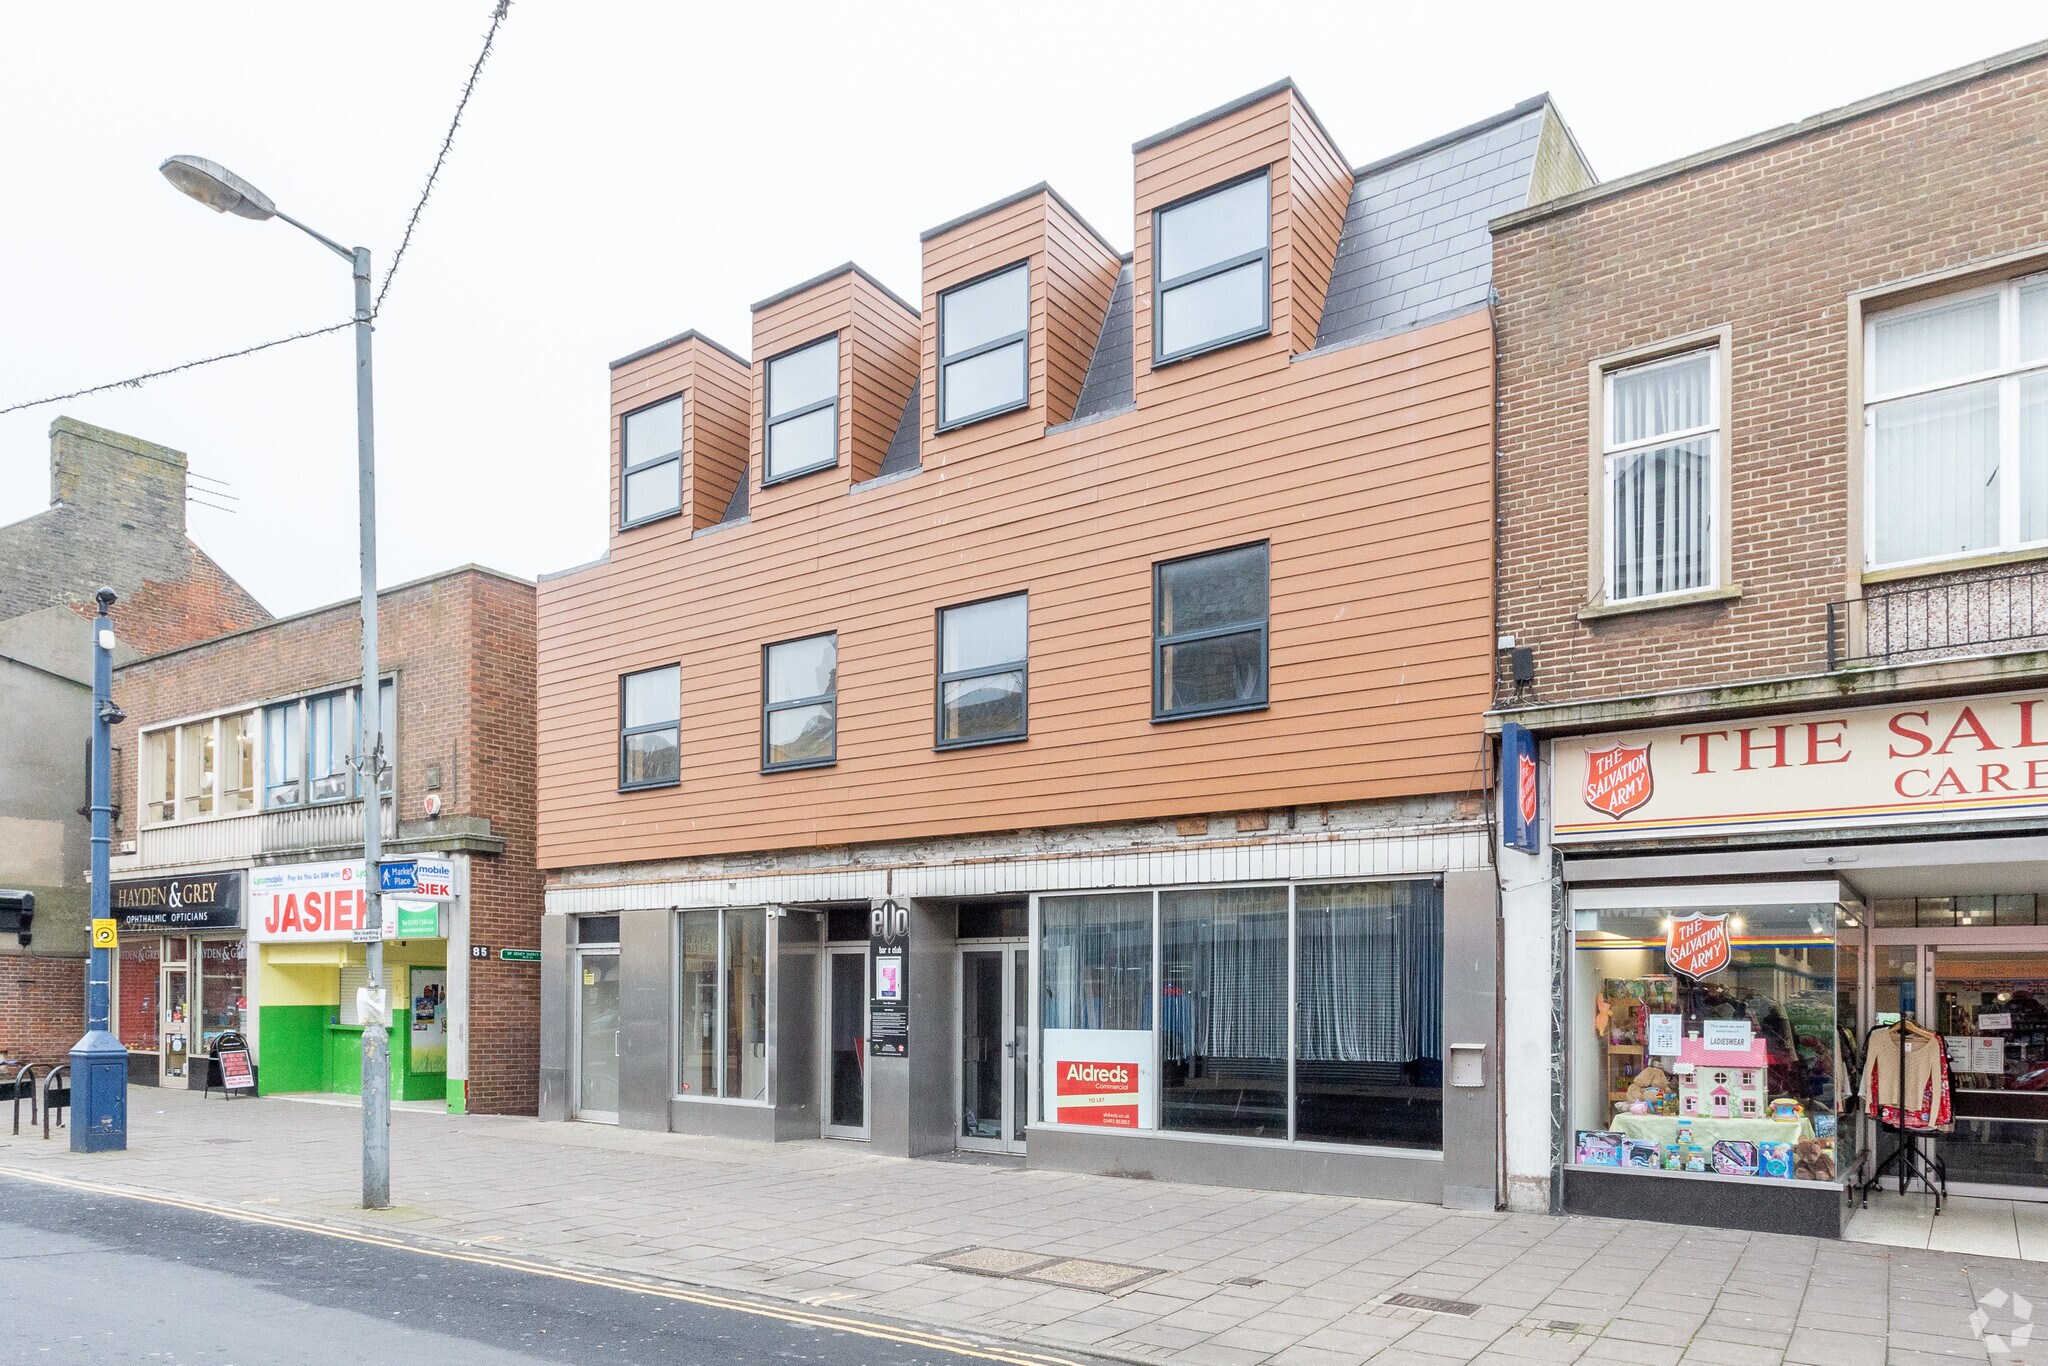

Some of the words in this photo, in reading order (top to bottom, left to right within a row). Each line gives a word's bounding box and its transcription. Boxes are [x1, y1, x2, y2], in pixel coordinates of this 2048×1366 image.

[1680, 719, 1852, 775] THE
[1596, 749, 1623, 775] THE
[1587, 750, 1648, 802] SALVATION
[1608, 773, 1645, 811] ARMY
[391, 867, 413, 876] Market
[394, 877, 411, 885] Place
[118, 886, 167, 907] HAYDEN
[168, 881, 184, 908] &
[183, 882, 218, 904] GREY
[126, 913, 167, 924] OPHTHALMIC
[171, 911, 208, 922] OPTICIANS
[1679, 919, 1702, 940] THE
[1670, 921, 1723, 964] SALVATION
[1689, 941, 1722, 972] ARMY
[1710, 1037, 1745, 1046] LADIESWEAR
[1066, 1064, 1129, 1083] Aldreds
